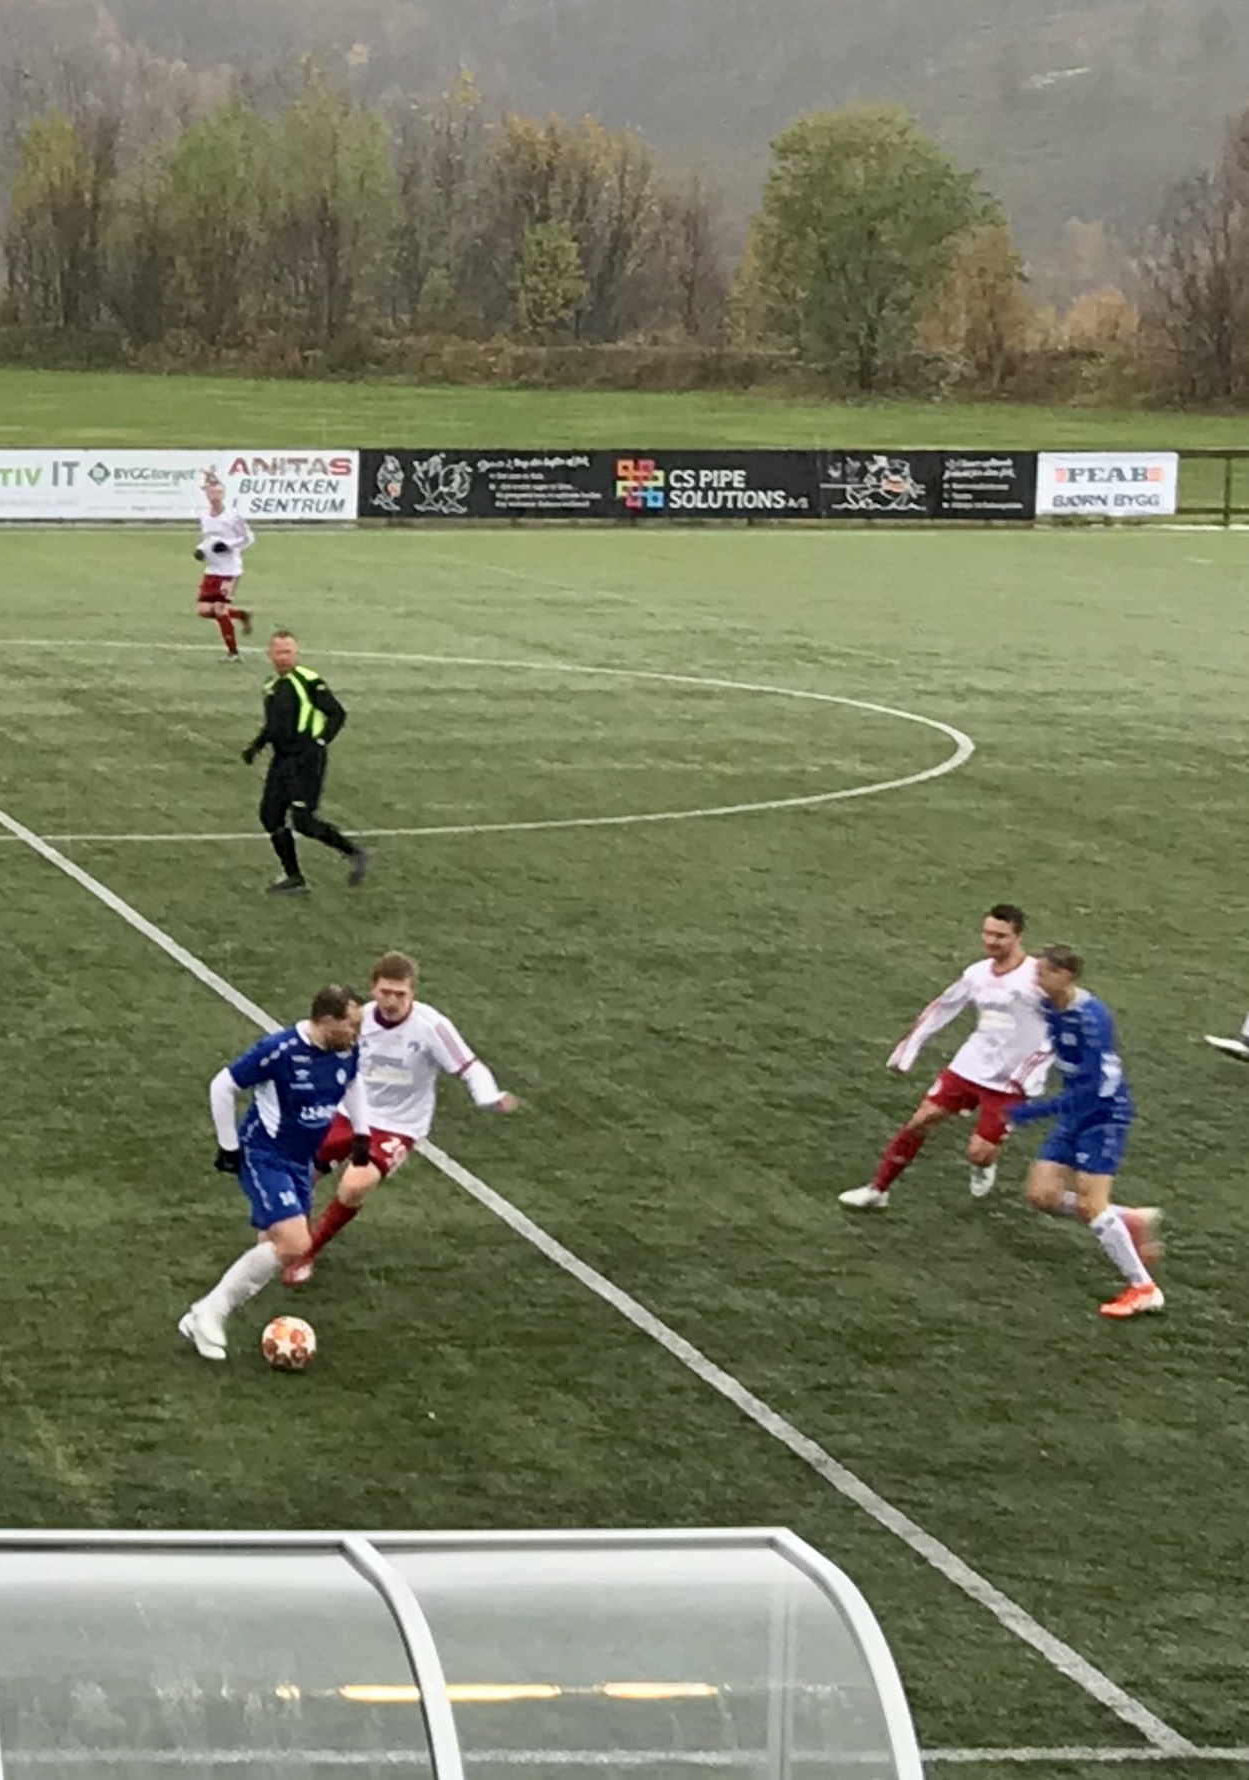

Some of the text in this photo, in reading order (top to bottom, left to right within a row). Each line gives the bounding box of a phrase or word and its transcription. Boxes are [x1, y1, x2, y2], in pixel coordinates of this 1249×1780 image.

[51, 461, 80, 487] IT
[228, 457, 352, 476] ANITAS
[1067, 466, 1149, 483] PEAB
[239, 479, 340, 494] BUTIKKEN
[669, 470, 747, 488] CS PIPE
[249, 498, 345, 513] SENTRUM
[669, 490, 786, 509] SOLUTIONS
[1114, 493, 1160, 506] BYGG
